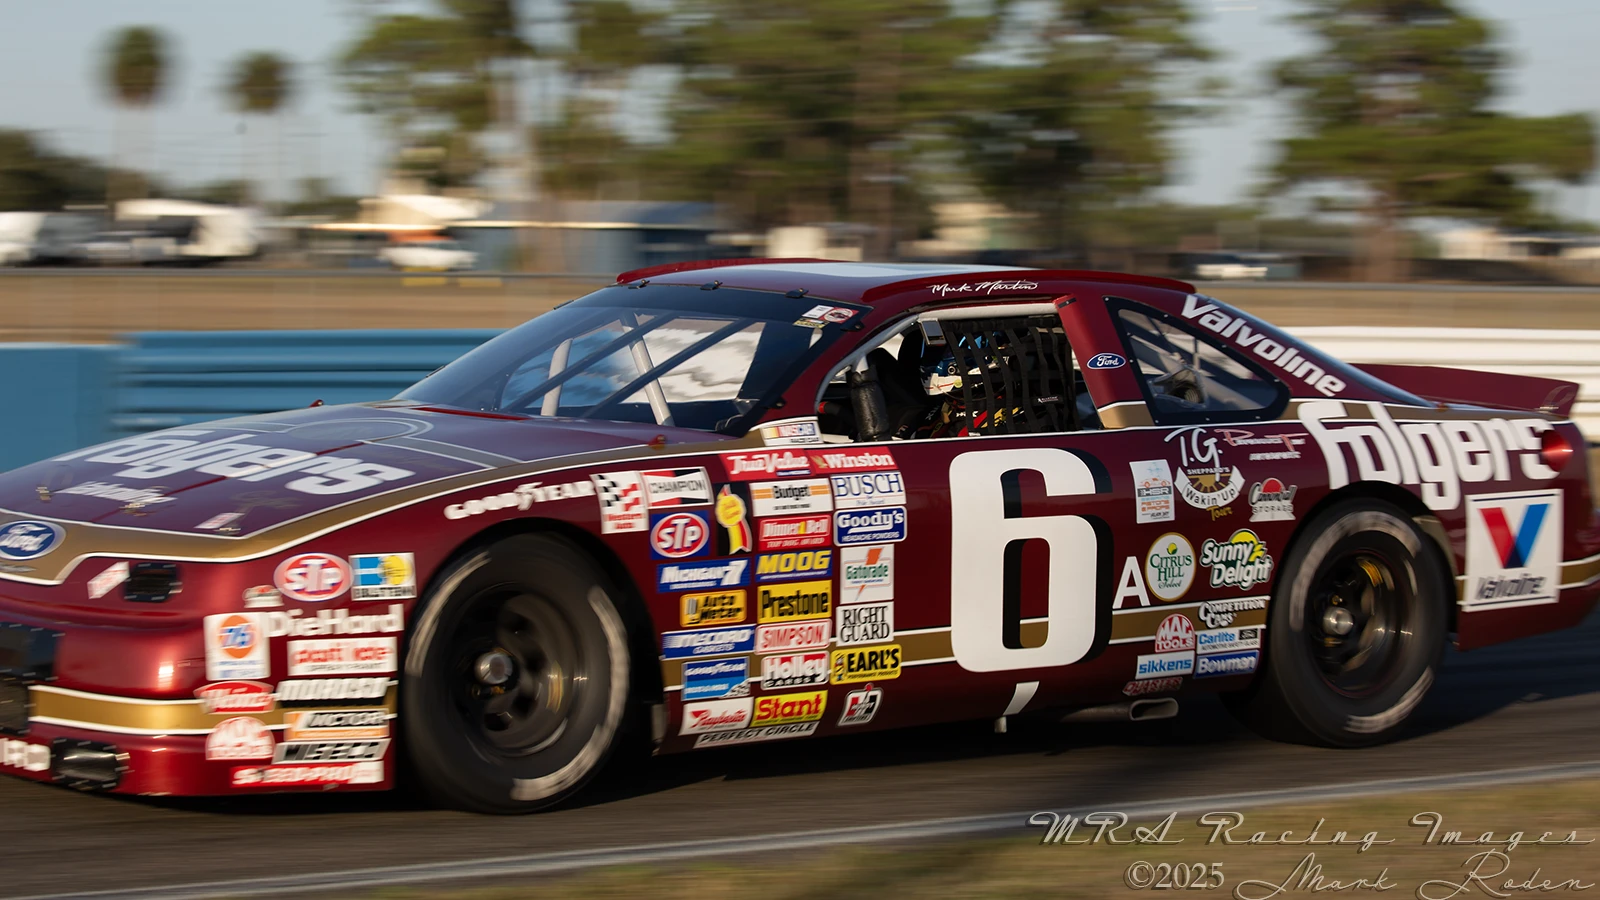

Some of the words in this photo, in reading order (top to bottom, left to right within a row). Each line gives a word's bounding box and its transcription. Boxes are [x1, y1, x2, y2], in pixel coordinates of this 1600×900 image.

[931, 283, 973, 296] Mark
[974, 279, 1039, 295] Martin
[1181, 295, 1347, 397] Valvoline
[1096, 355, 1120, 367] Ford
[823, 453, 896, 469] Winston
[1297, 401, 1562, 511] Folgers
[650, 479, 707, 494] CHAMPION
[773, 485, 811, 501] Budget
[832, 473, 904, 498] BUSCH
[444, 481, 596, 520] GOODYEAR
[838, 510, 905, 529] Goody's
[1206, 505, 1233, 521] Tour
[657, 517, 702, 550] STP
[756, 550, 832, 575] MOOG
[949, 448, 1097, 672] 6
[1150, 553, 1193, 569] CITRUS
[1202, 539, 1253, 565] Sunny
[284, 558, 344, 593] STP
[846, 563, 889, 580] Gatorade
[1112, 556, 1151, 609] A
[1157, 567, 1185, 582] HILL
[1212, 557, 1272, 588] Delight
[1158, 578, 1182, 589] Select
[761, 590, 829, 619] Prestone
[842, 605, 889, 626] RIGHT
[266, 604, 404, 637] DieHard
[1158, 615, 1192, 641] MAC
[763, 625, 824, 649] SIMPSON
[840, 623, 890, 643] GUARD
[1157, 636, 1194, 650] TOOLS
[1199, 632, 1236, 645] Carlite
[765, 656, 827, 681] Holley
[847, 648, 899, 673] EARL'S
[1138, 658, 1193, 674] sikkens
[1199, 656, 1256, 674] Bowman
[756, 693, 822, 721] Stant
[701, 729, 763, 743] PERFECT
[765, 722, 814, 736] CIRCLE
